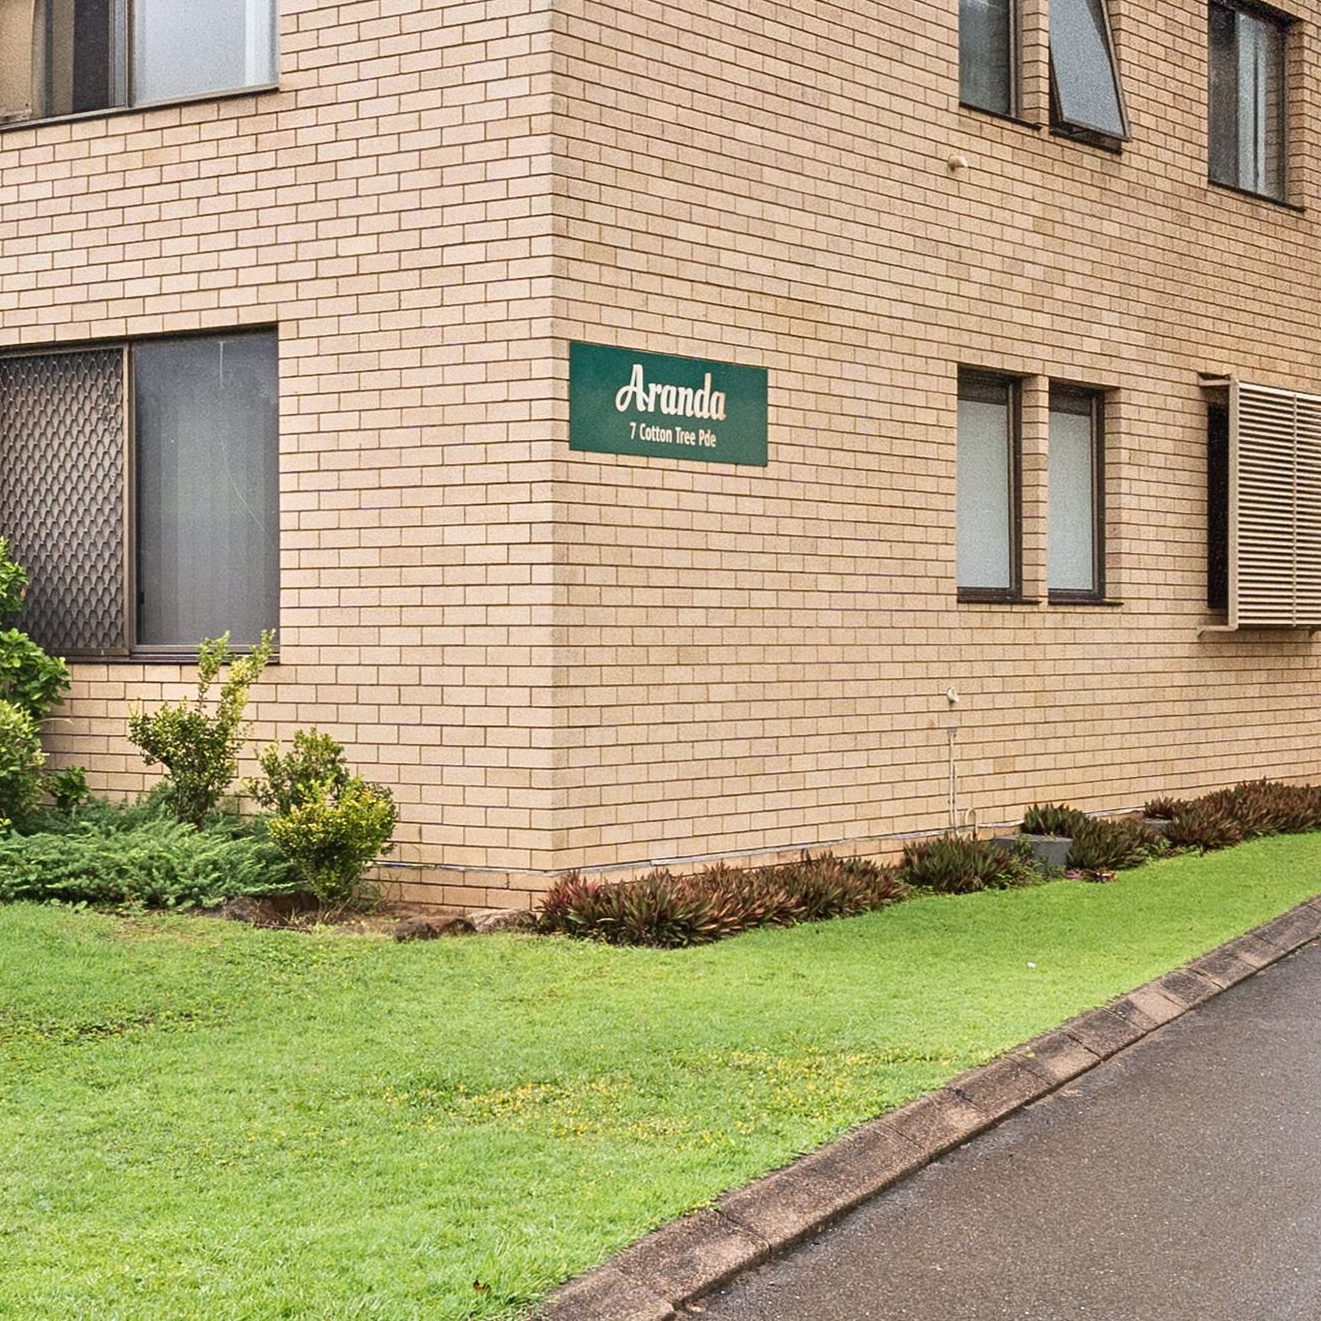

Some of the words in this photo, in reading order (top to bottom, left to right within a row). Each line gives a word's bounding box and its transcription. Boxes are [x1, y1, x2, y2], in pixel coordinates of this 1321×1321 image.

[615, 364, 726, 421] Aranda
[629, 422, 636, 440] 7
[639, 423, 673, 443] Cotton
[675, 426, 696, 446] Tree
[698, 429, 716, 448] Pde
